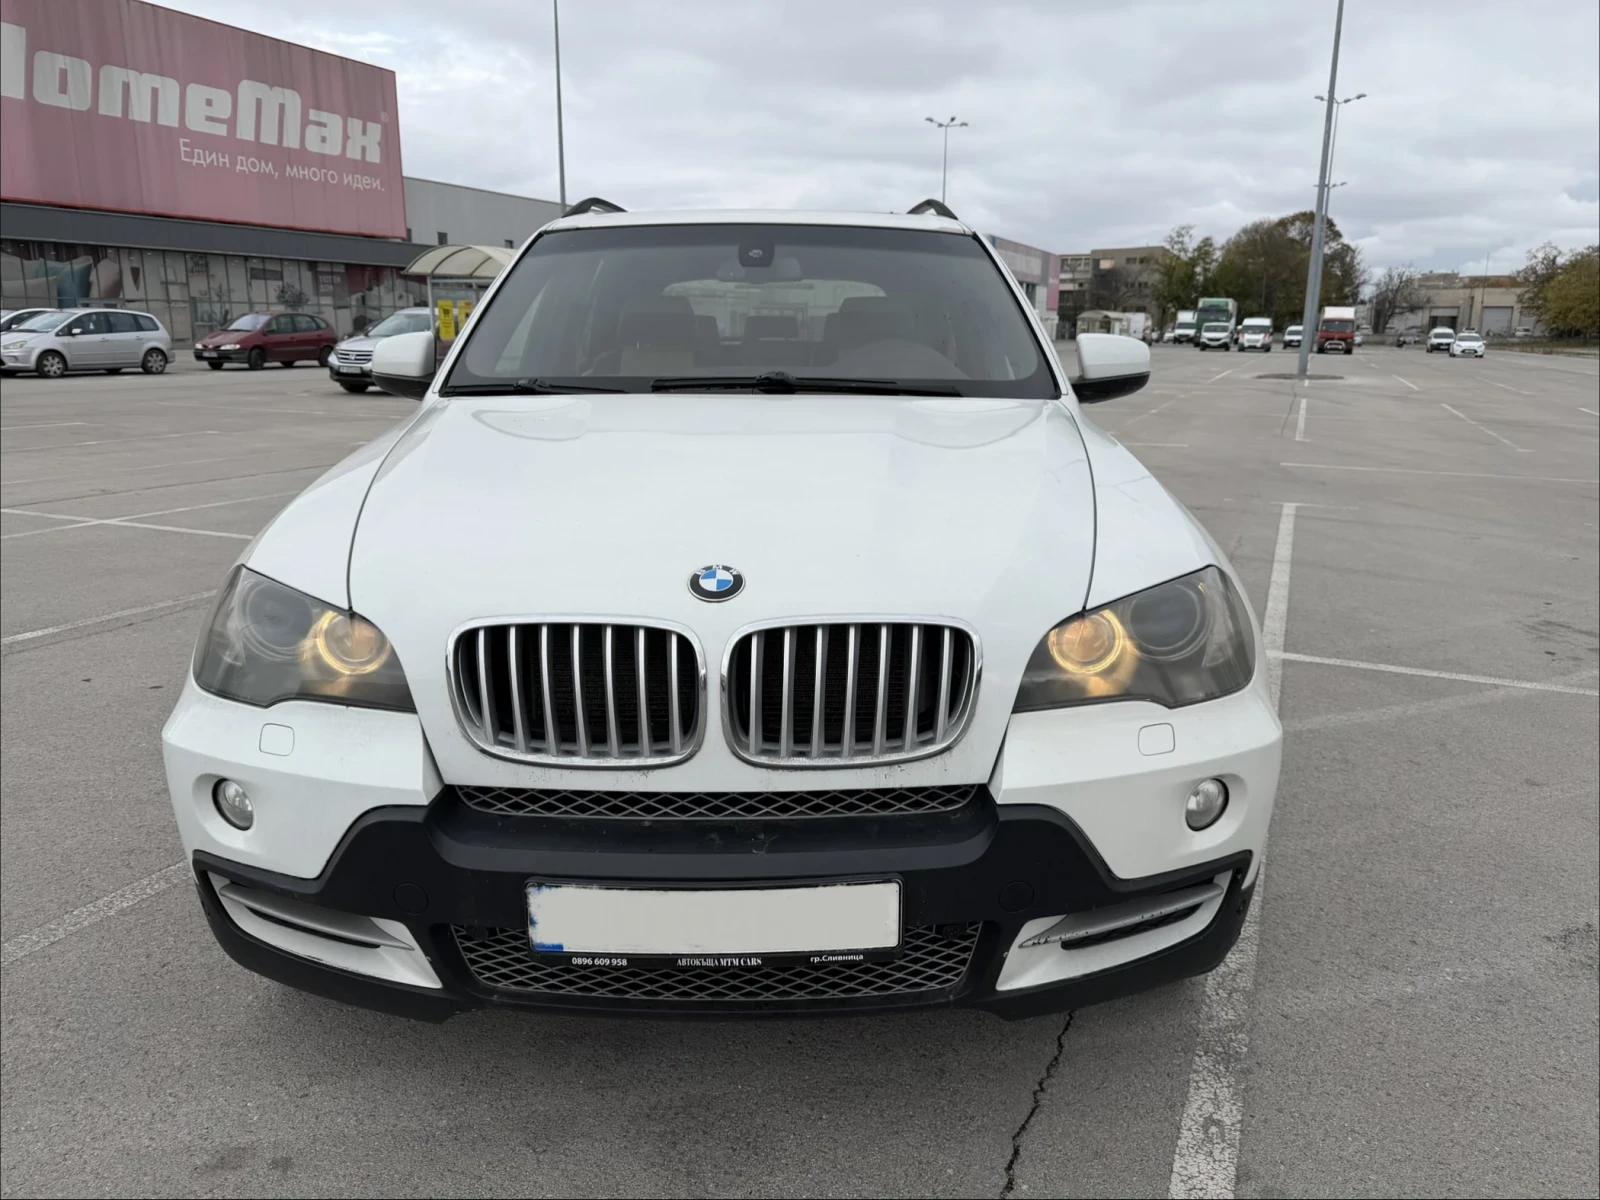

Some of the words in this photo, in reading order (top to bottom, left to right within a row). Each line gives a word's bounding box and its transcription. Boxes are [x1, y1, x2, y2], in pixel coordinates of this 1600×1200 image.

[179, 137, 230, 168] Един
[236, 155, 279, 180] дом,
[285, 163, 338, 184] много
[342, 171, 385, 192] идеи.
[571, 956, 593, 966] 0896
[594, 957, 610, 966] 609
[611, 958, 628, 967] 958
[740, 957, 762, 967] CARS
